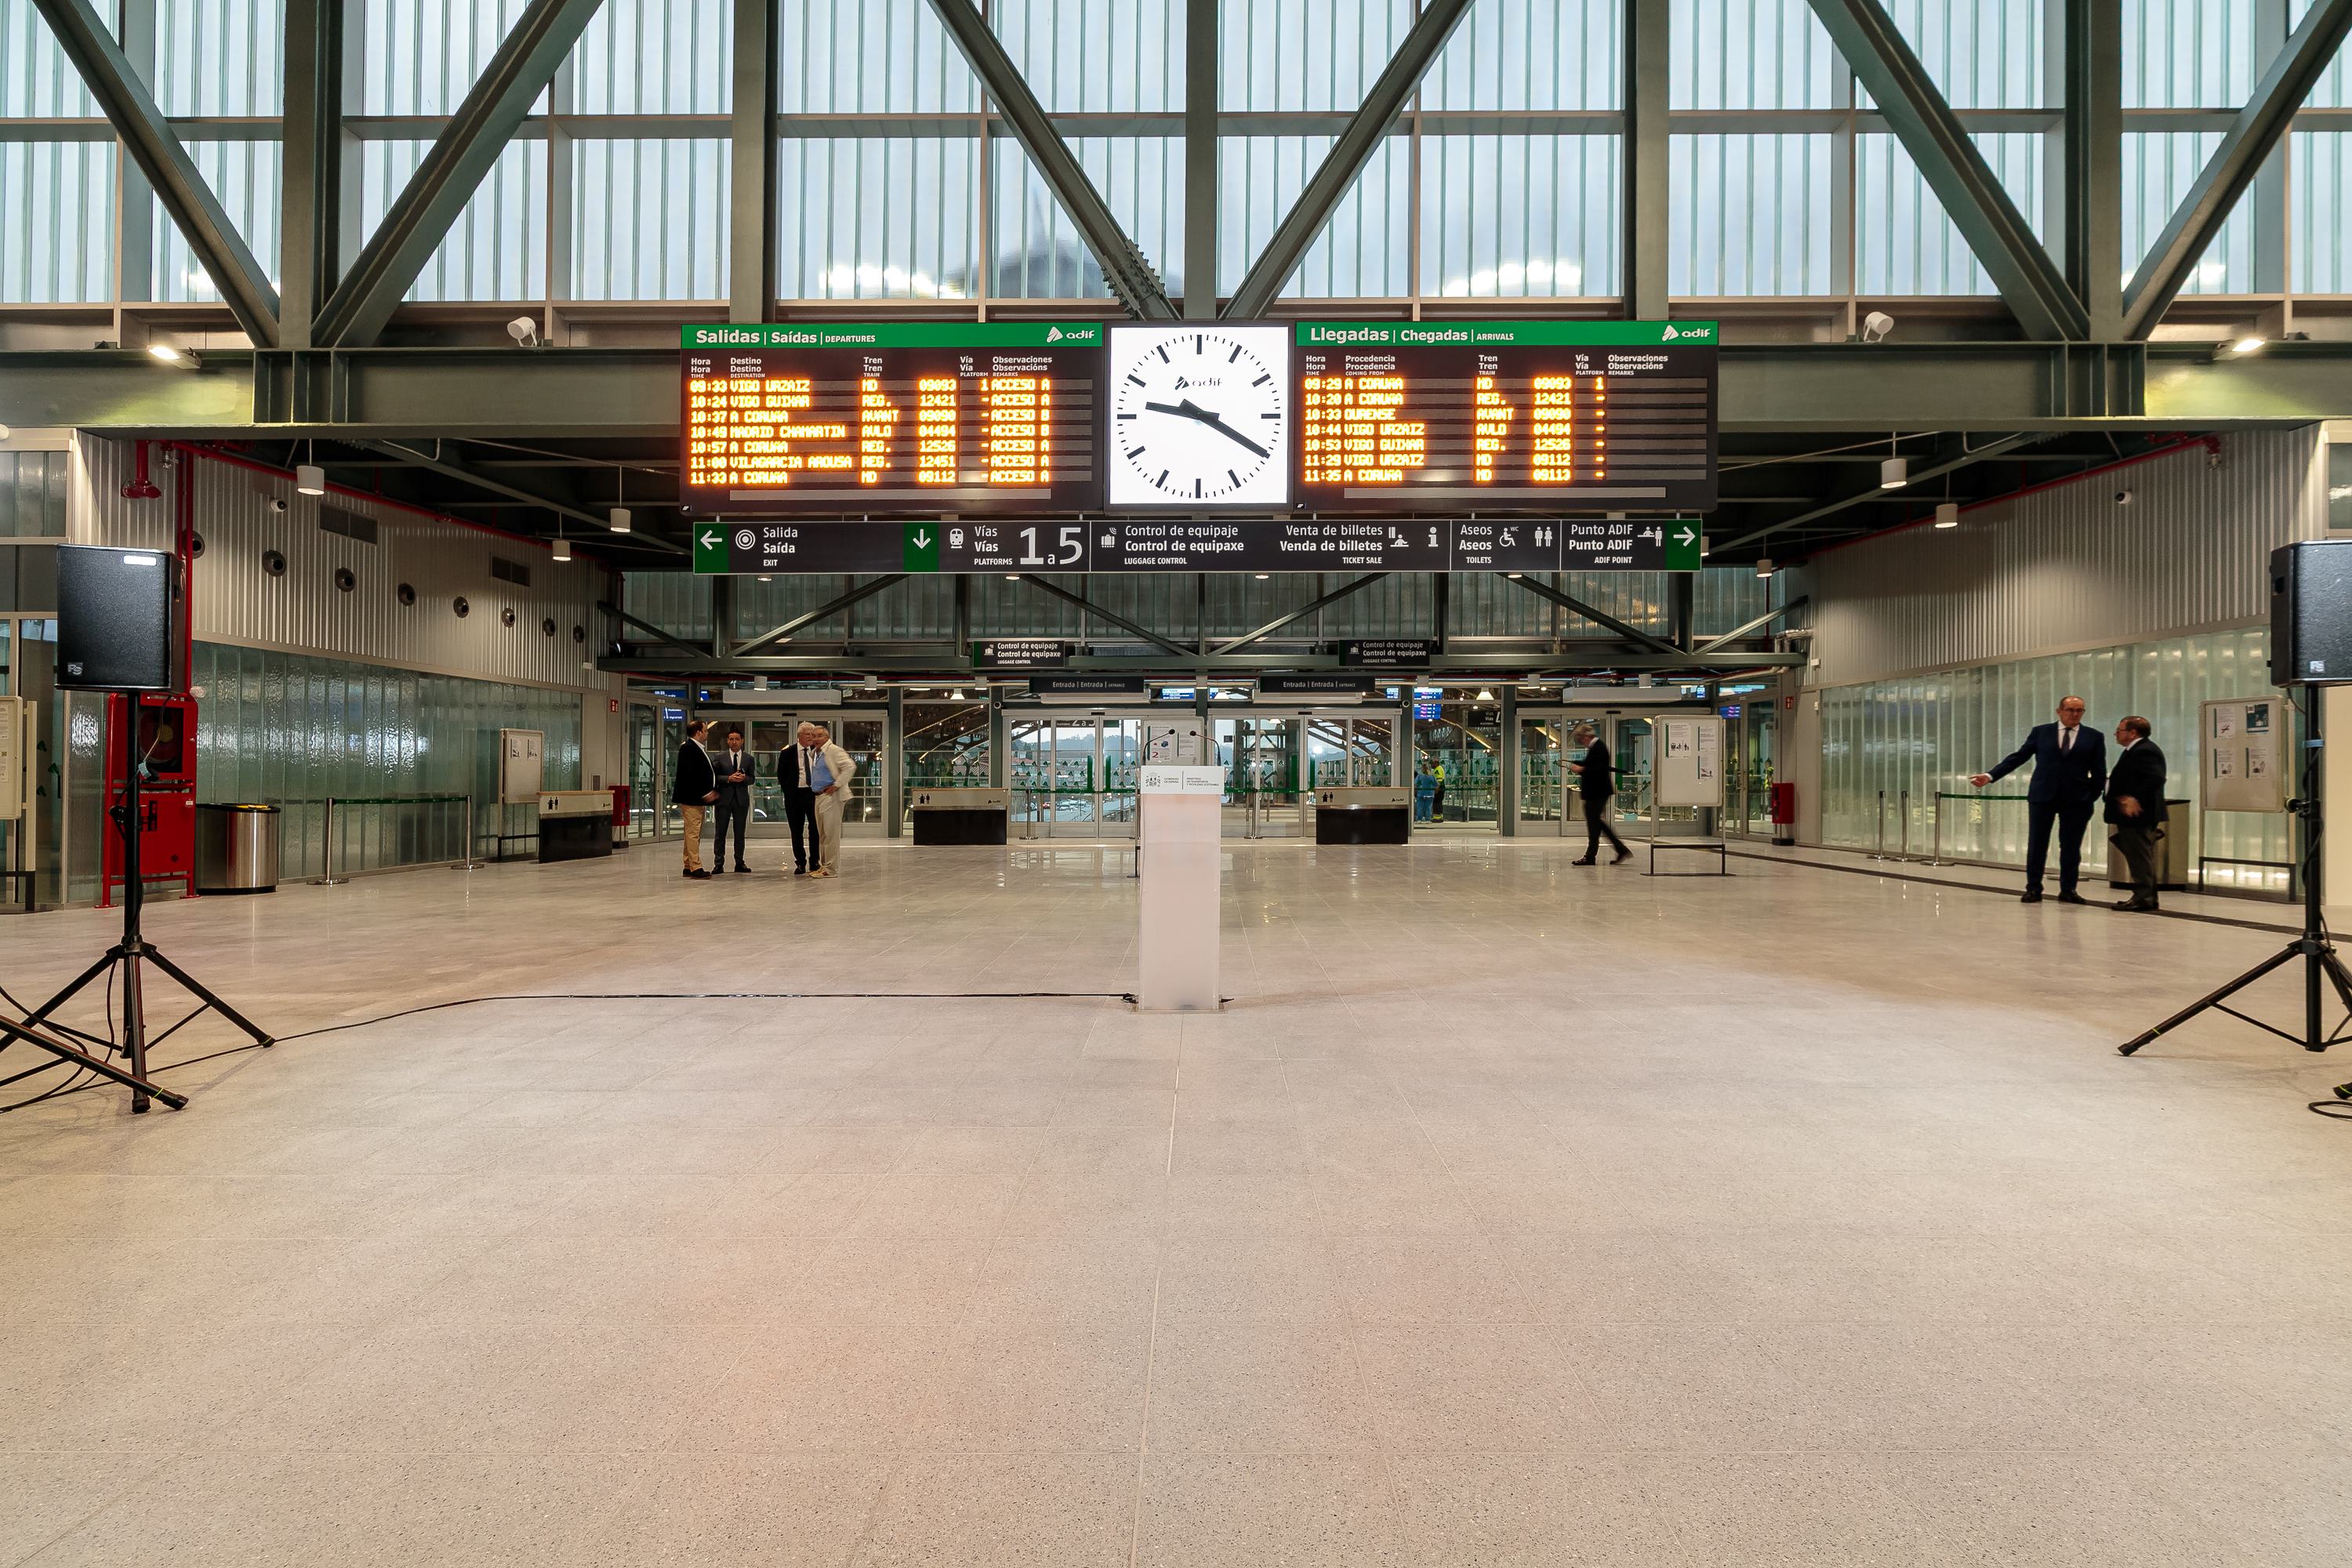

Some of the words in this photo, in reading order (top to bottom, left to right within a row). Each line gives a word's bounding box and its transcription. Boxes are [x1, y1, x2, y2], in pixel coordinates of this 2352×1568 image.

[696, 329, 760, 343] Salidas
[771, 331, 817, 343] Saídas
[1066, 330, 1094, 339] adif
[1311, 328, 1388, 343] Llegadas
[1401, 329, 1468, 343] Chegadas
[1682, 328, 1710, 337] adif
[691, 380, 728, 392] 09:33
[730, 380, 760, 392] VIGO
[766, 380, 810, 392] URZAIZ
[1192, 377, 1222, 386] adif
[1305, 378, 1341, 390] 09:29
[1345, 379, 1353, 390] A
[1359, 378, 1403, 390] CORUÑA
[691, 396, 727, 408] 10:24
[730, 396, 760, 408] VIGO
[766, 395, 809, 407] GUIXAR
[1305, 394, 1341, 405] 10:20
[1345, 394, 1353, 405] A
[1359, 394, 1403, 405] CORUÑA
[691, 411, 727, 423] 10:37
[731, 411, 739, 423] A
[745, 411, 788, 423] CORUÑA
[1305, 408, 1341, 420] 10:33
[1345, 408, 1396, 420] OURENSE
[691, 426, 727, 438] 10:49
[731, 426, 774, 438] MADRID
[780, 426, 845, 437] CHAMARTIN
[1305, 424, 1341, 435] 10:44
[1345, 424, 1374, 435] VIGO
[1380, 424, 1425, 435] URZAIZ
[691, 441, 727, 453] 10:57
[730, 441, 738, 453] A
[745, 441, 788, 453] CORUÑA
[1305, 439, 1341, 451] 10:53
[1345, 439, 1374, 451] VIGO
[1380, 439, 1424, 451] GUIXAR
[691, 457, 727, 469] 11:00
[730, 456, 802, 468] VILAGARCIA
[808, 456, 852, 468] AROUSA
[1305, 454, 1341, 466] 11:29
[1344, 454, 1374, 466] VIGO
[1380, 454, 1424, 466] URZAIZ
[691, 472, 727, 484] 11:33
[730, 472, 738, 484] A
[744, 471, 787, 483] CORUÑA
[1305, 470, 1341, 481] 11:35
[1344, 470, 1352, 481] A
[1358, 470, 1402, 481] CORUÑA
[764, 527, 797, 538] Salida
[975, 525, 997, 536] Vías
[1126, 525, 1165, 535] Control
[1171, 525, 1183, 535] de
[1189, 525, 1238, 538] equipaje
[1287, 525, 1318, 535] Venta
[1323, 525, 1337, 535] de
[1341, 524, 1382, 535] billetes
[1461, 524, 1492, 535] Aseos
[1572, 524, 1604, 535] Punto
[1608, 524, 1633, 535] ADIF
[764, 542, 795, 553] Saída
[975, 540, 998, 551] Vías
[1020, 528, 1044, 564] 1
[1048, 554, 1054, 564] a
[1060, 528, 1082, 564] 5
[1126, 541, 1167, 551] Control
[1171, 540, 1185, 550] de
[1190, 540, 1243, 553] equipaxe
[1280, 541, 1316, 550] Venda
[1321, 540, 1335, 550] de
[1340, 540, 1382, 550] billetes
[1459, 540, 1491, 550] Aseos
[1570, 540, 1603, 550] Punto
[1607, 539, 1632, 550] ADIF
